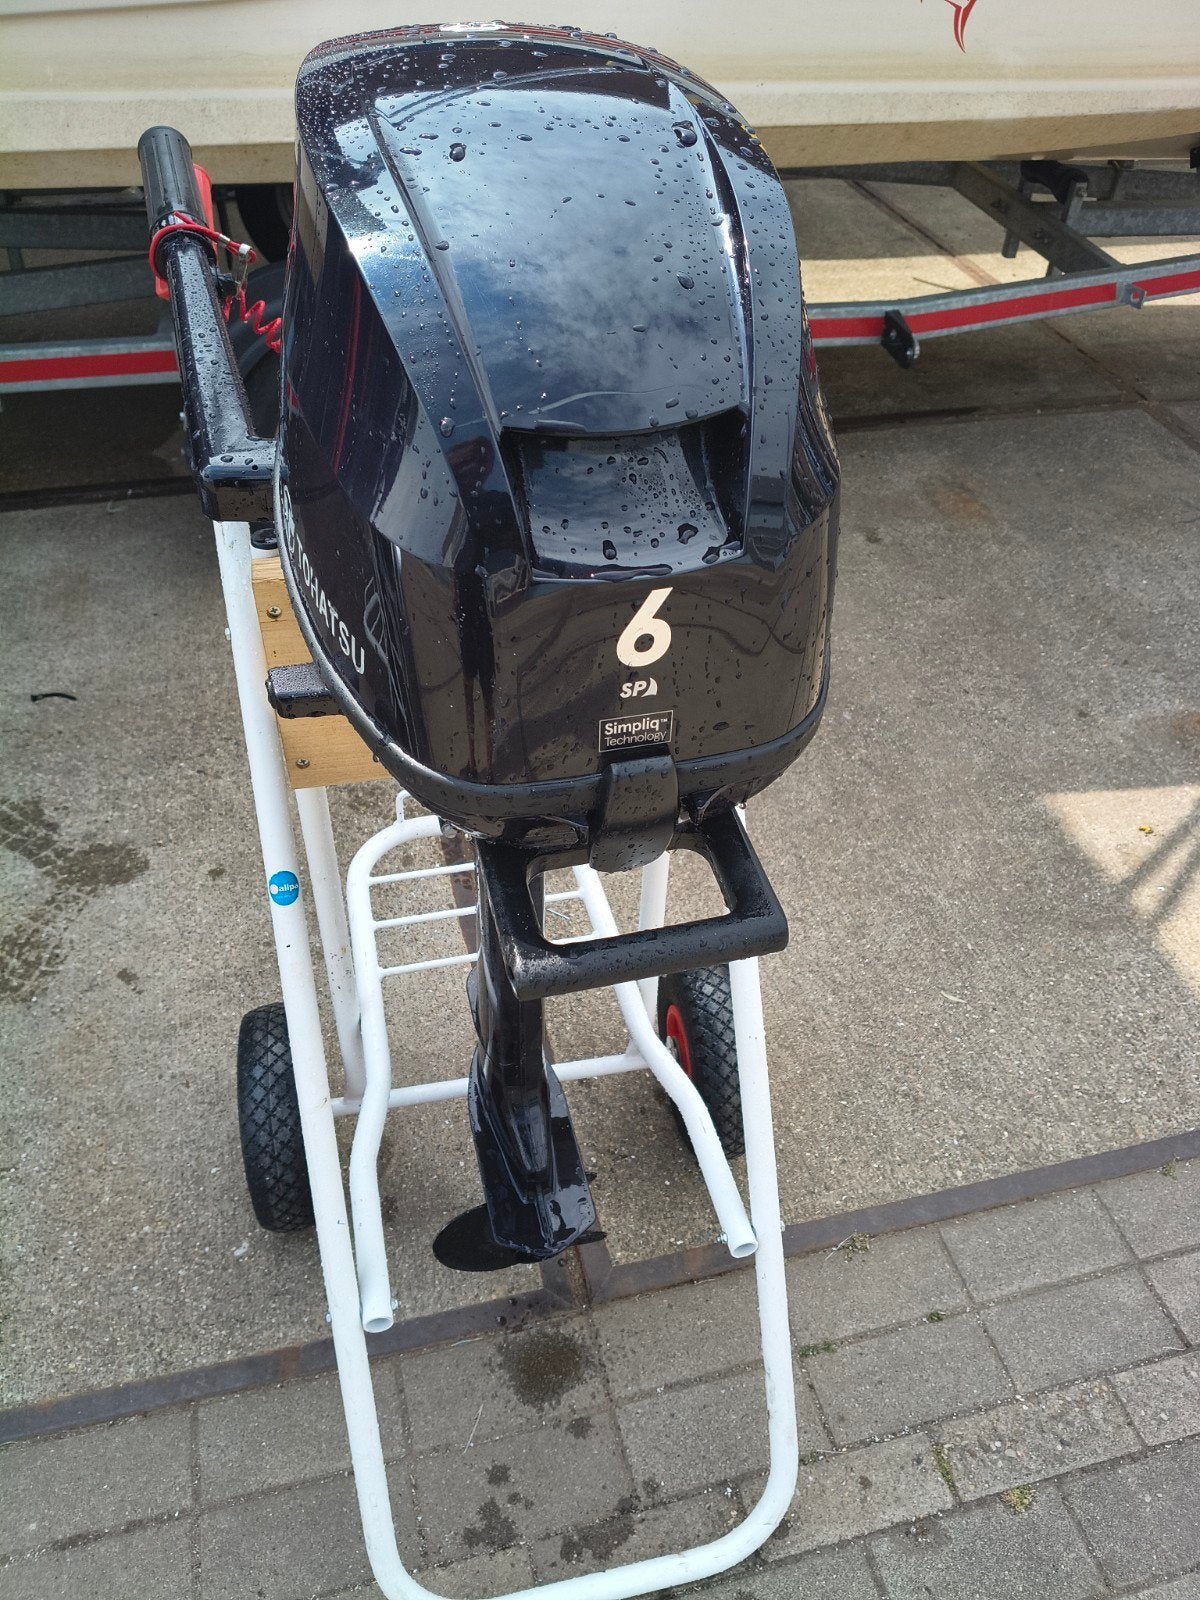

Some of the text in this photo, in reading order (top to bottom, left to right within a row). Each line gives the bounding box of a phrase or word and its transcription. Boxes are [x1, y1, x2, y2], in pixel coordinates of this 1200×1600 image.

[296, 534, 365, 675] TOHATSU
[616, 587, 673, 667] 6
[604, 730, 667, 747] Technology
